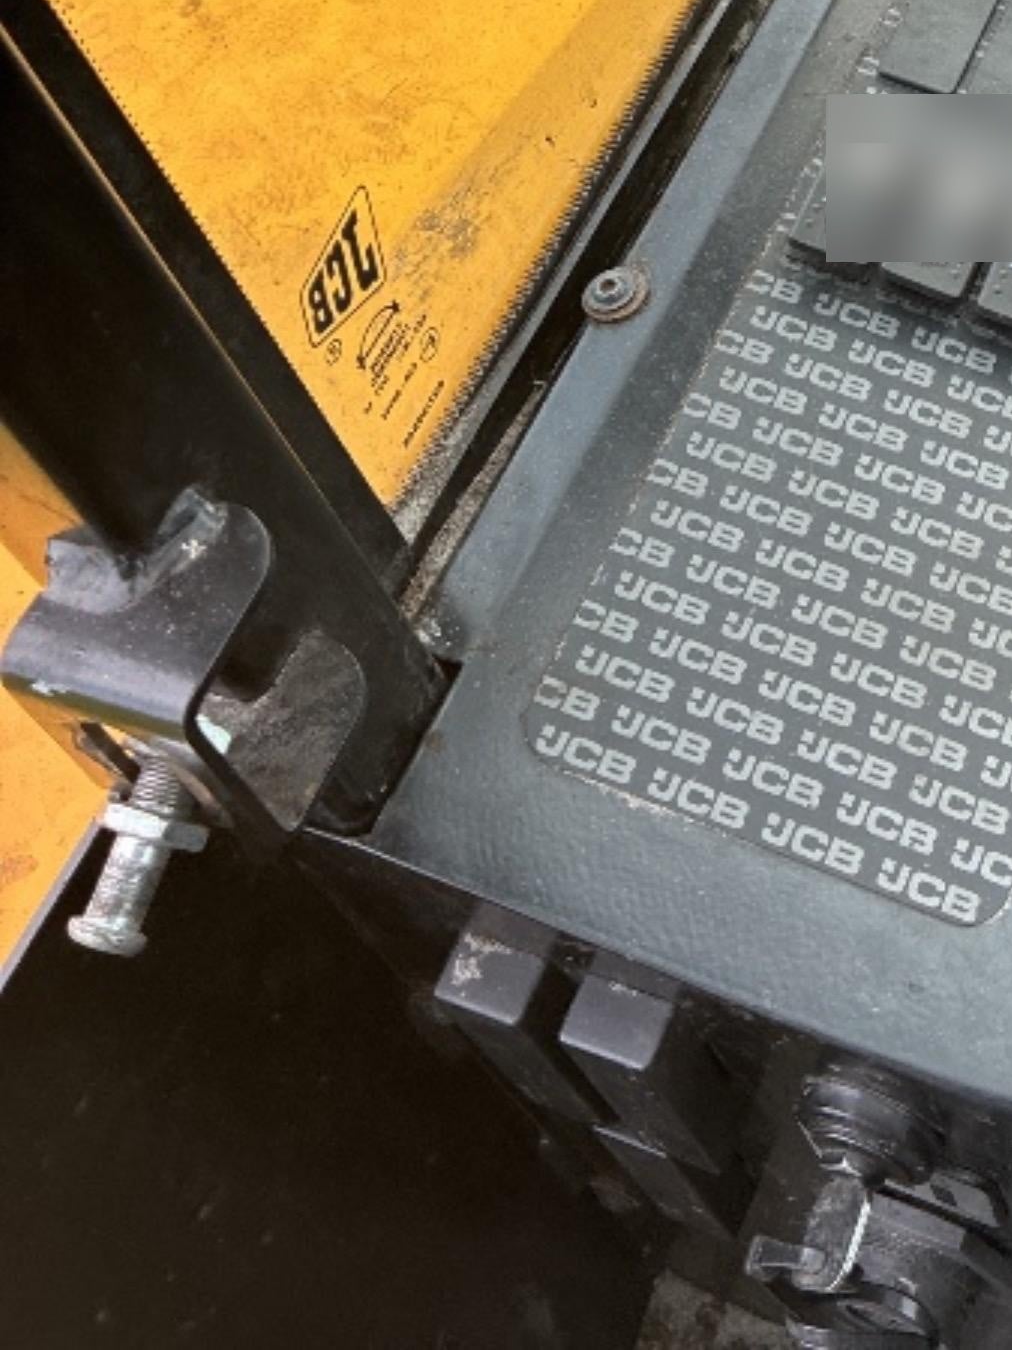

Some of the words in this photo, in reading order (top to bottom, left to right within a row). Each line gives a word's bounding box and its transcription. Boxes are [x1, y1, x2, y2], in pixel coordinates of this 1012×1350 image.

[714, 329, 774, 363] CB
[784, 354, 872, 401] JCB
[884, 390, 972, 438] JCB
[745, 269, 802, 303] CB
[815, 294, 900, 338] JCB
[912, 327, 996, 372] JCB
[750, 306, 837, 351] JCB
[848, 340, 935, 387] JCB
[683, 393, 741, 429] CB
[753, 417, 843, 466] JCB
[855, 454, 945, 504] JCB
[720, 366, 807, 414] JCB
[819, 402, 908, 451] JCB
[921, 441, 1009, 489] JCB
[646, 458, 708, 497] CB
[720, 486, 812, 536] JCB
[824, 522, 917, 576] JCB
[687, 432, 777, 482] JCB
[788, 470, 879, 519] JCB
[891, 507, 984, 559] JCB
[609, 527, 675, 567] CB
[687, 555, 780, 609] JCB
[792, 594, 888, 649] JCB
[900, 636, 996, 691] JCB
[651, 501, 744, 552] JCB
[756, 539, 849, 591] JCB
[861, 578, 955, 632] JCB
[573, 600, 639, 642] CB
[649, 628, 747, 684] JCB
[759, 670, 856, 726] JCB
[870, 711, 968, 771] JCB
[614, 572, 710, 624] JCB
[721, 611, 817, 666] JCB
[830, 652, 927, 708] JCB
[534, 676, 600, 720] CB
[612, 705, 711, 764] JCB
[722, 748, 824, 808] JCB
[837, 792, 938, 855] JCB
[576, 645, 675, 702] JCB
[686, 687, 784, 744] JCB
[797, 729, 897, 789] JCB
[909, 775, 1010, 834] JCB
[536, 724, 636, 783] JCB
[648, 768, 750, 828] JCB
[762, 813, 864, 873] JCB
[877, 858, 980, 921] JCB
